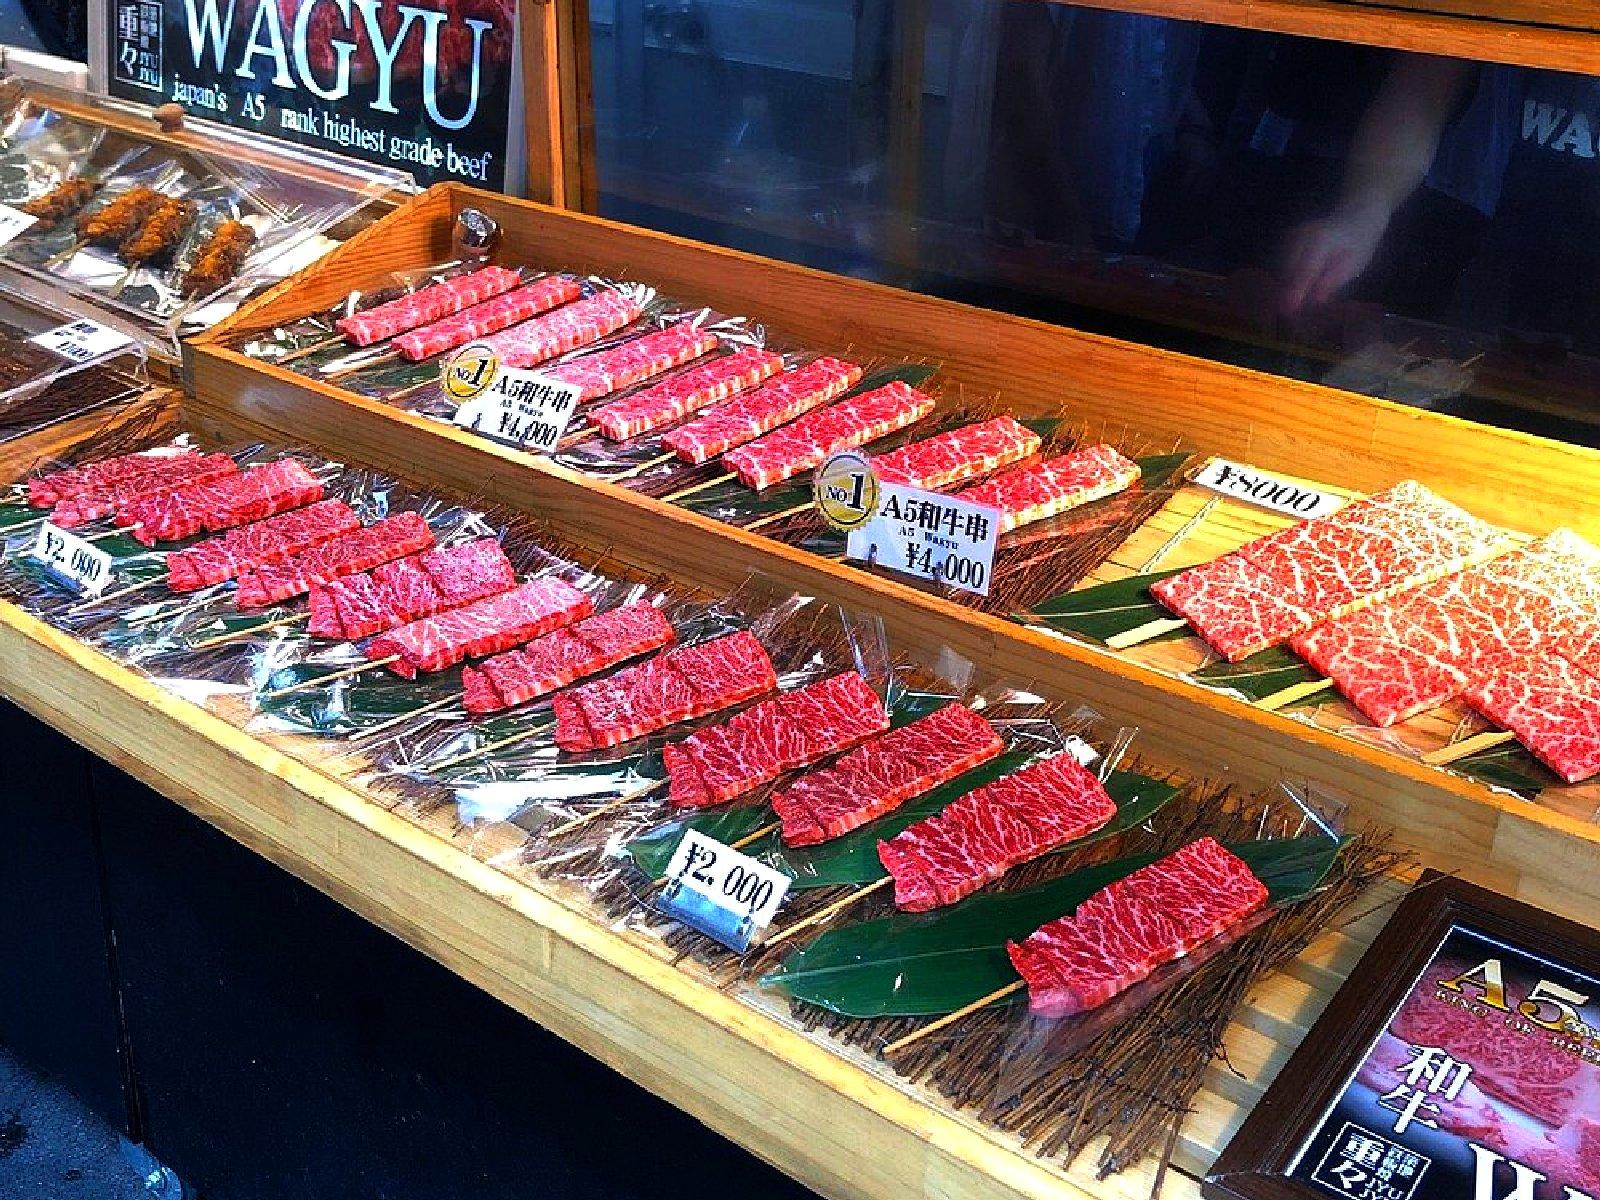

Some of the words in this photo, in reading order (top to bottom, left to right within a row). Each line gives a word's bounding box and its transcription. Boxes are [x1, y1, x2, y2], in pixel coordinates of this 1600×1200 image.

[185, 0, 492, 130] WAGYU
[172, 72, 229, 112] japan's
[241, 92, 266, 121] A5
[323, 111, 386, 153] highest
[389, 137, 444, 168] grade
[447, 143, 493, 182] beef
[879, 494, 989, 543] A5和牛串
[1214, 465, 1321, 512] ¥8000
[1437, 959, 1590, 1033] A5
[1378, 1046, 1473, 1134] 和牛
[1329, 1132, 1385, 1189] 重々
